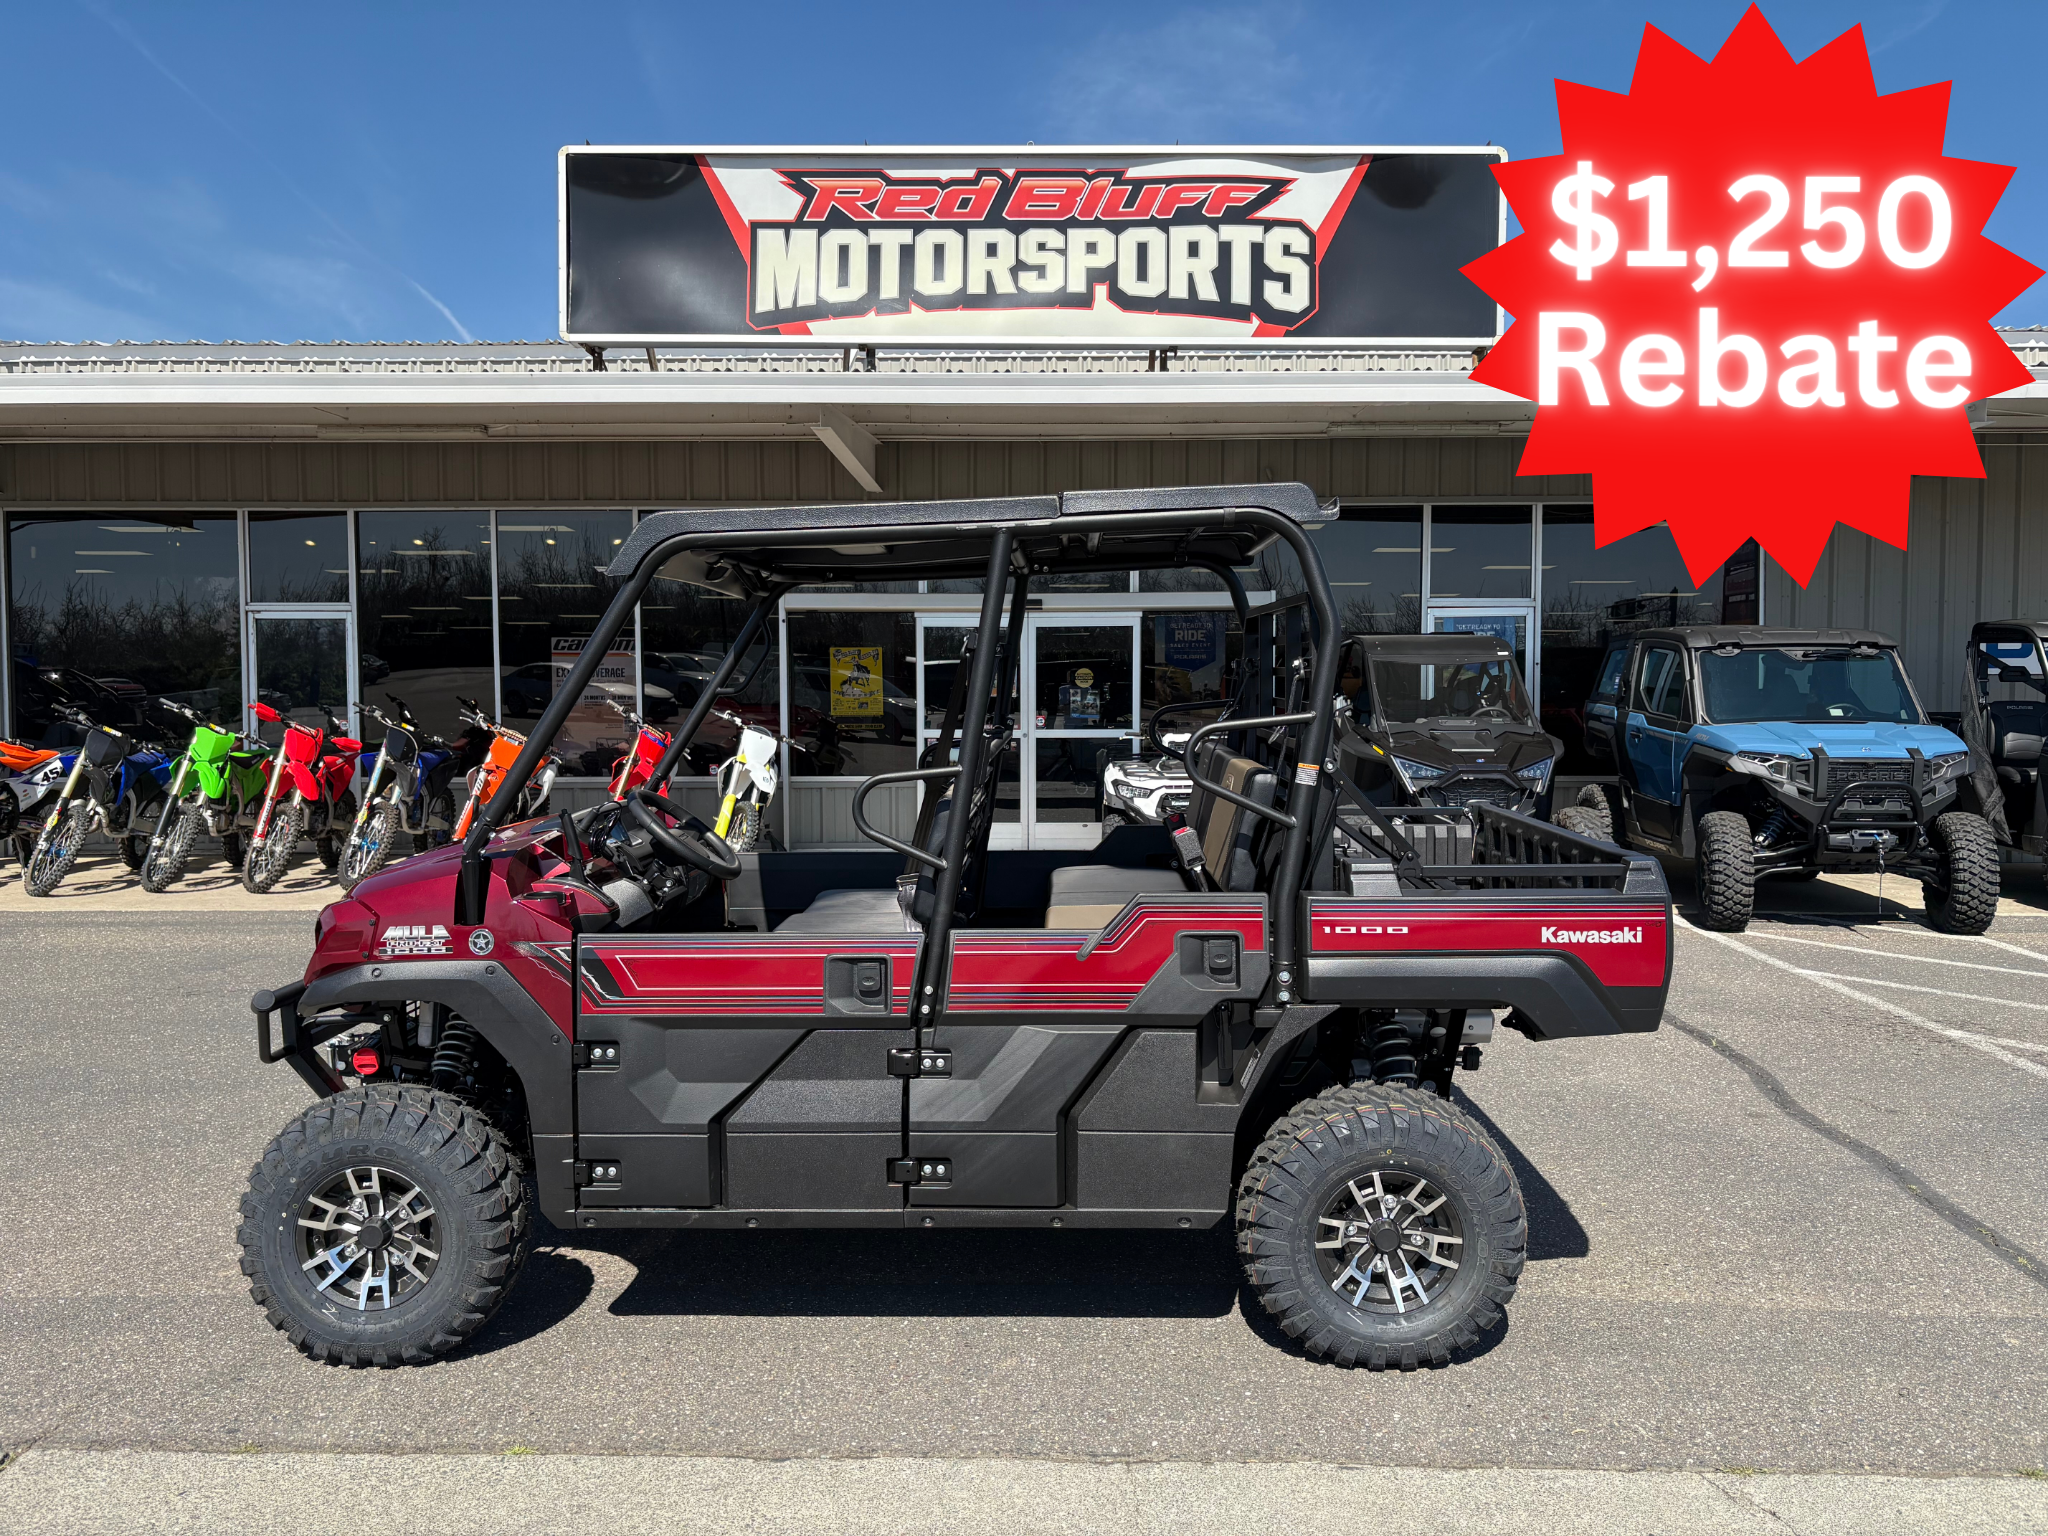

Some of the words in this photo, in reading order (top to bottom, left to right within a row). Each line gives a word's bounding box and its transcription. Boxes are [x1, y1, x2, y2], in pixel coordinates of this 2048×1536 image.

[801, 176, 1002, 221] Red
[755, 225, 1310, 313] MOTORSPORTS
[1174, 630, 1206, 642] RIDE
[41, 766, 61, 784] 45
[1836, 771, 1906, 781] POLARIS
[380, 925, 453, 941] MULE
[1322, 926, 1409, 935] 1000
[1541, 926, 1643, 944] Kawasaki
[299, 1143, 397, 1181] DURO
[1443, 1175, 1489, 1258] DURO
